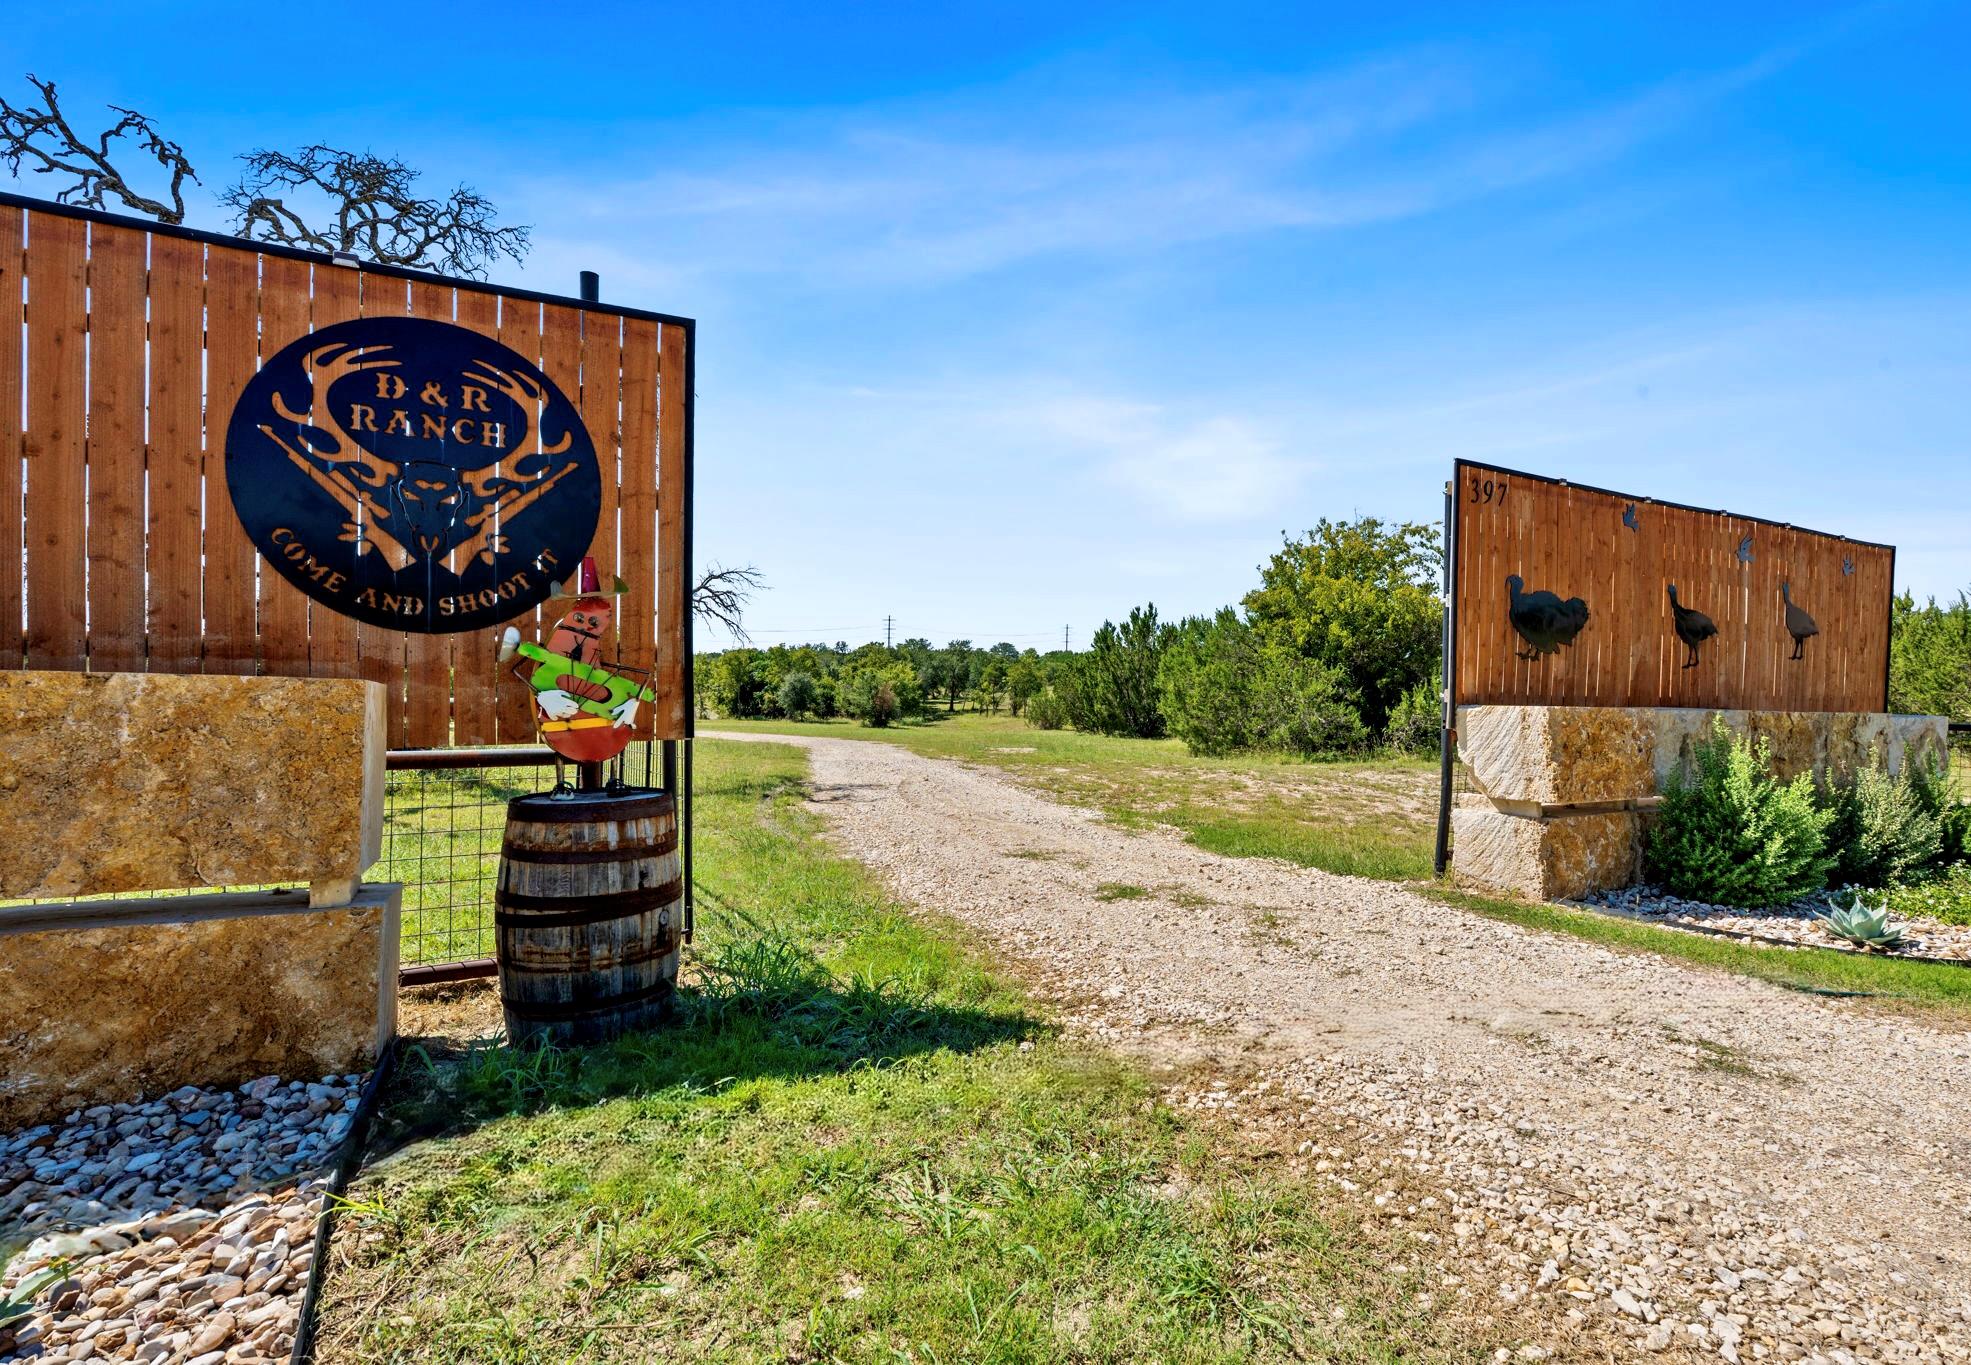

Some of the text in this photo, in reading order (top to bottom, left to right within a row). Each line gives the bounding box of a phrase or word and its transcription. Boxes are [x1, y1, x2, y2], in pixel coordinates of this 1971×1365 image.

[376, 372, 492, 412] D & R
[349, 403, 506, 448] RANCH
[1471, 478, 1507, 506] 397
[271, 528, 559, 616] COME AND SHOOT IT
